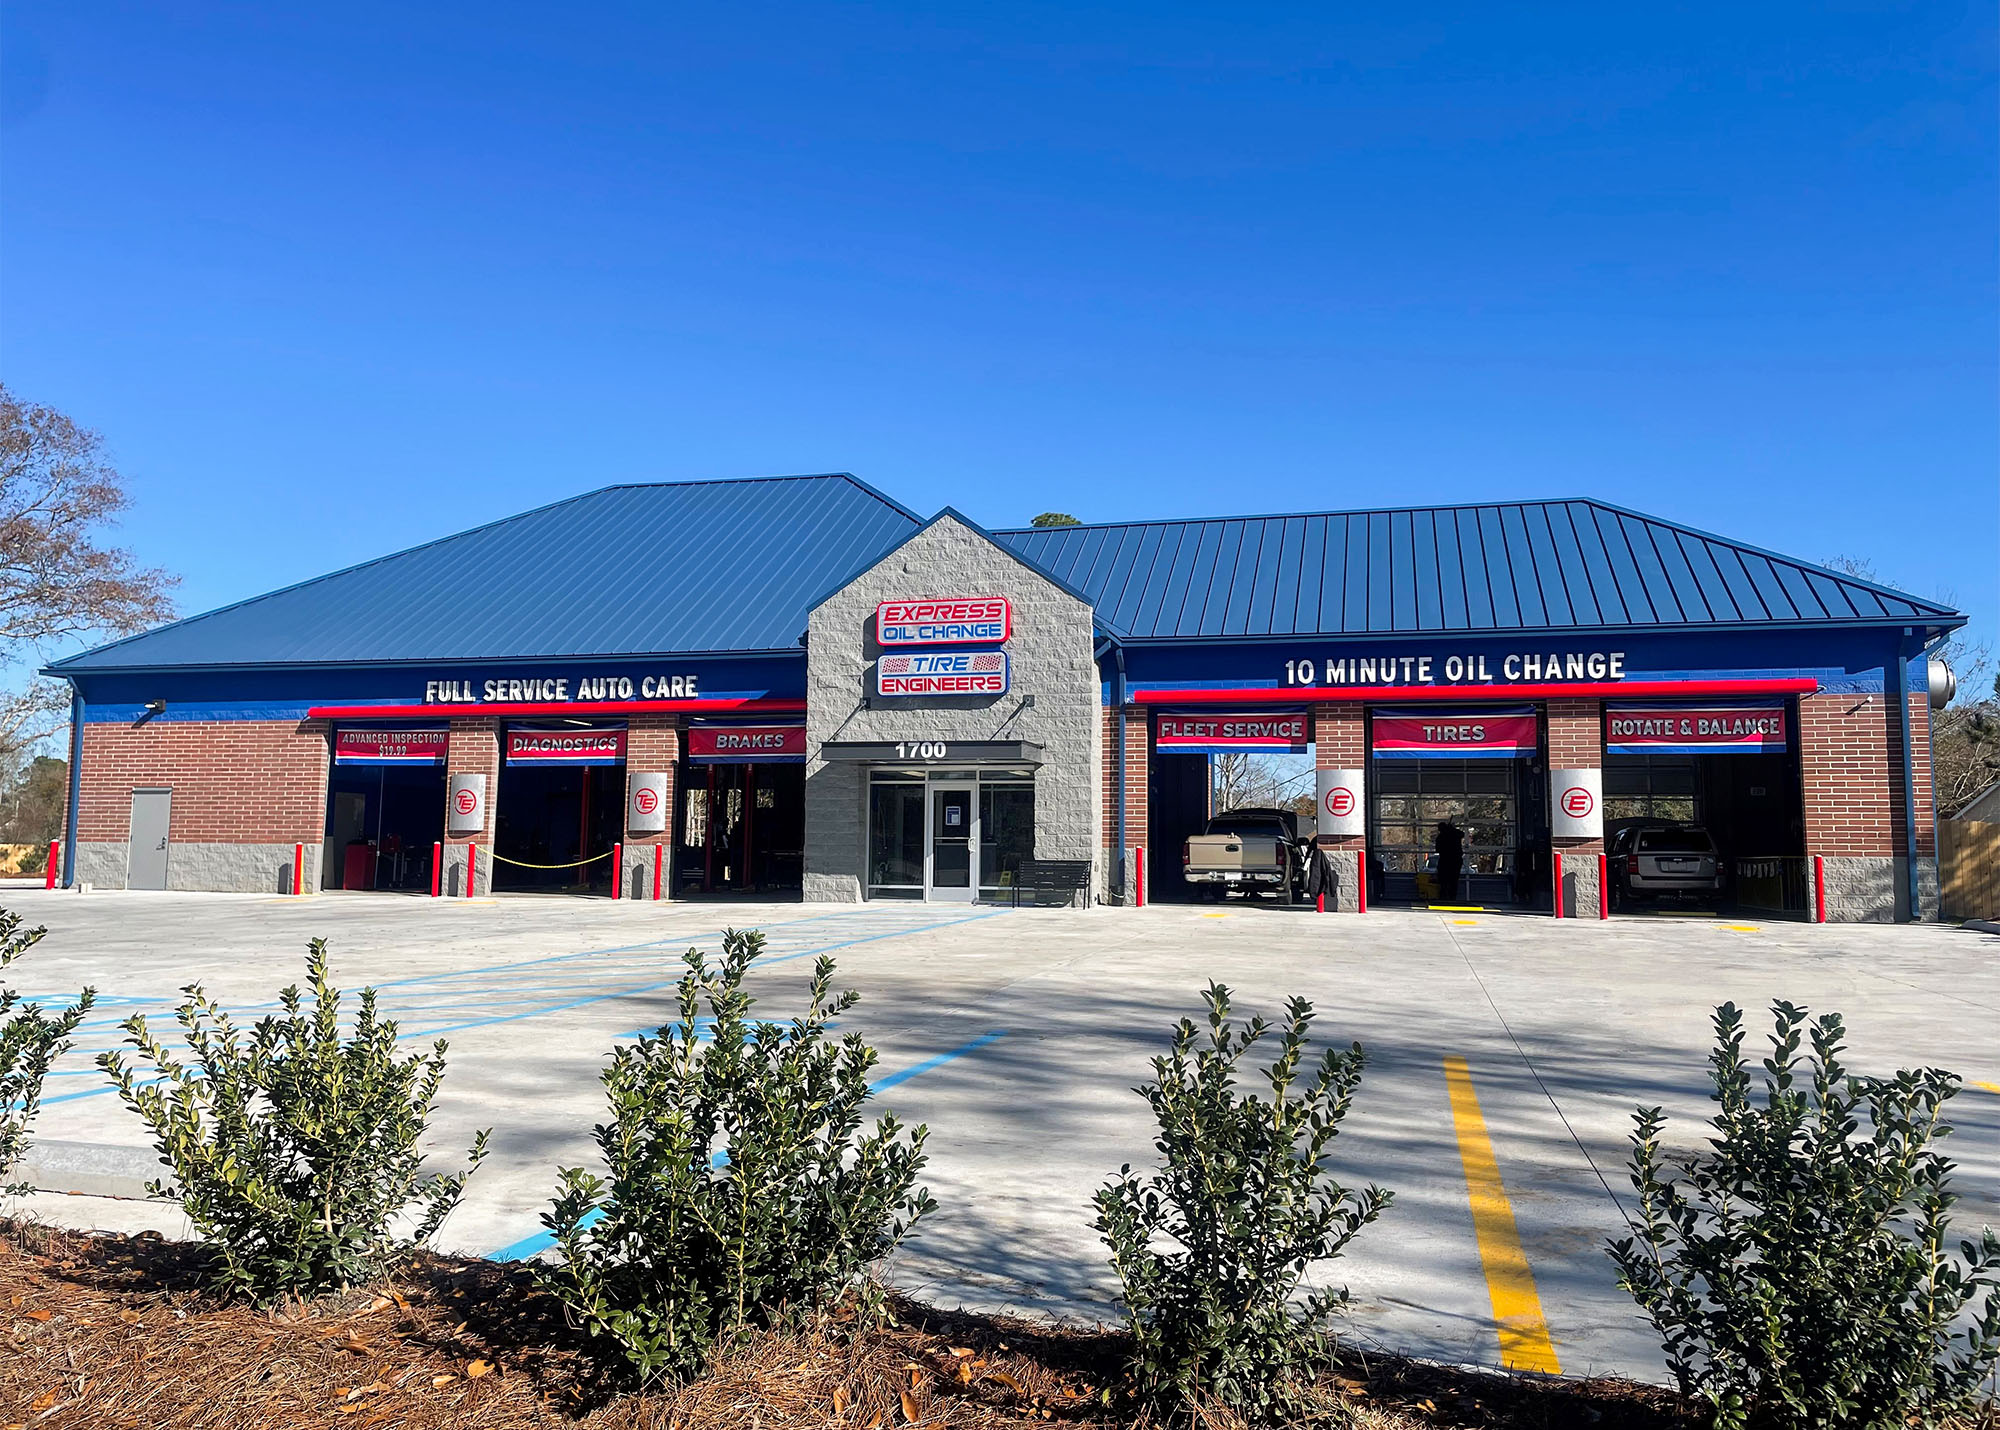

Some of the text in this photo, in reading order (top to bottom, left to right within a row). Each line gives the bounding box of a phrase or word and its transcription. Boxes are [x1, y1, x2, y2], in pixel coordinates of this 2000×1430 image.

[884, 603, 1003, 622] EXPRESS
[884, 624, 1001, 640] OIL CHANGE
[913, 656, 969, 672] TIRE
[1285, 652, 1625, 685] 10 MINUTE OIL CHANGE
[425, 675, 698, 702] FULL SERVICE AUTO CARE
[882, 676, 1002, 692] ENGINEERS
[1161, 721, 1303, 737] FLEET SERVICE
[1422, 725, 1486, 741] TIRES
[1612, 717, 1780, 736] ROTATE & BALANCE
[342, 733, 445, 744] ADVANCED INSPECTION
[513, 737, 618, 752] DIAGNOSTICS
[716, 733, 784, 749] BRAKES
[379, 744, 407, 757] $19.99
[895, 742, 946, 758] 1700
[457, 795, 474, 810] TE
[638, 794, 655, 809] TE
[1332, 794, 1350, 809] E
[1567, 795, 1588, 810] E
